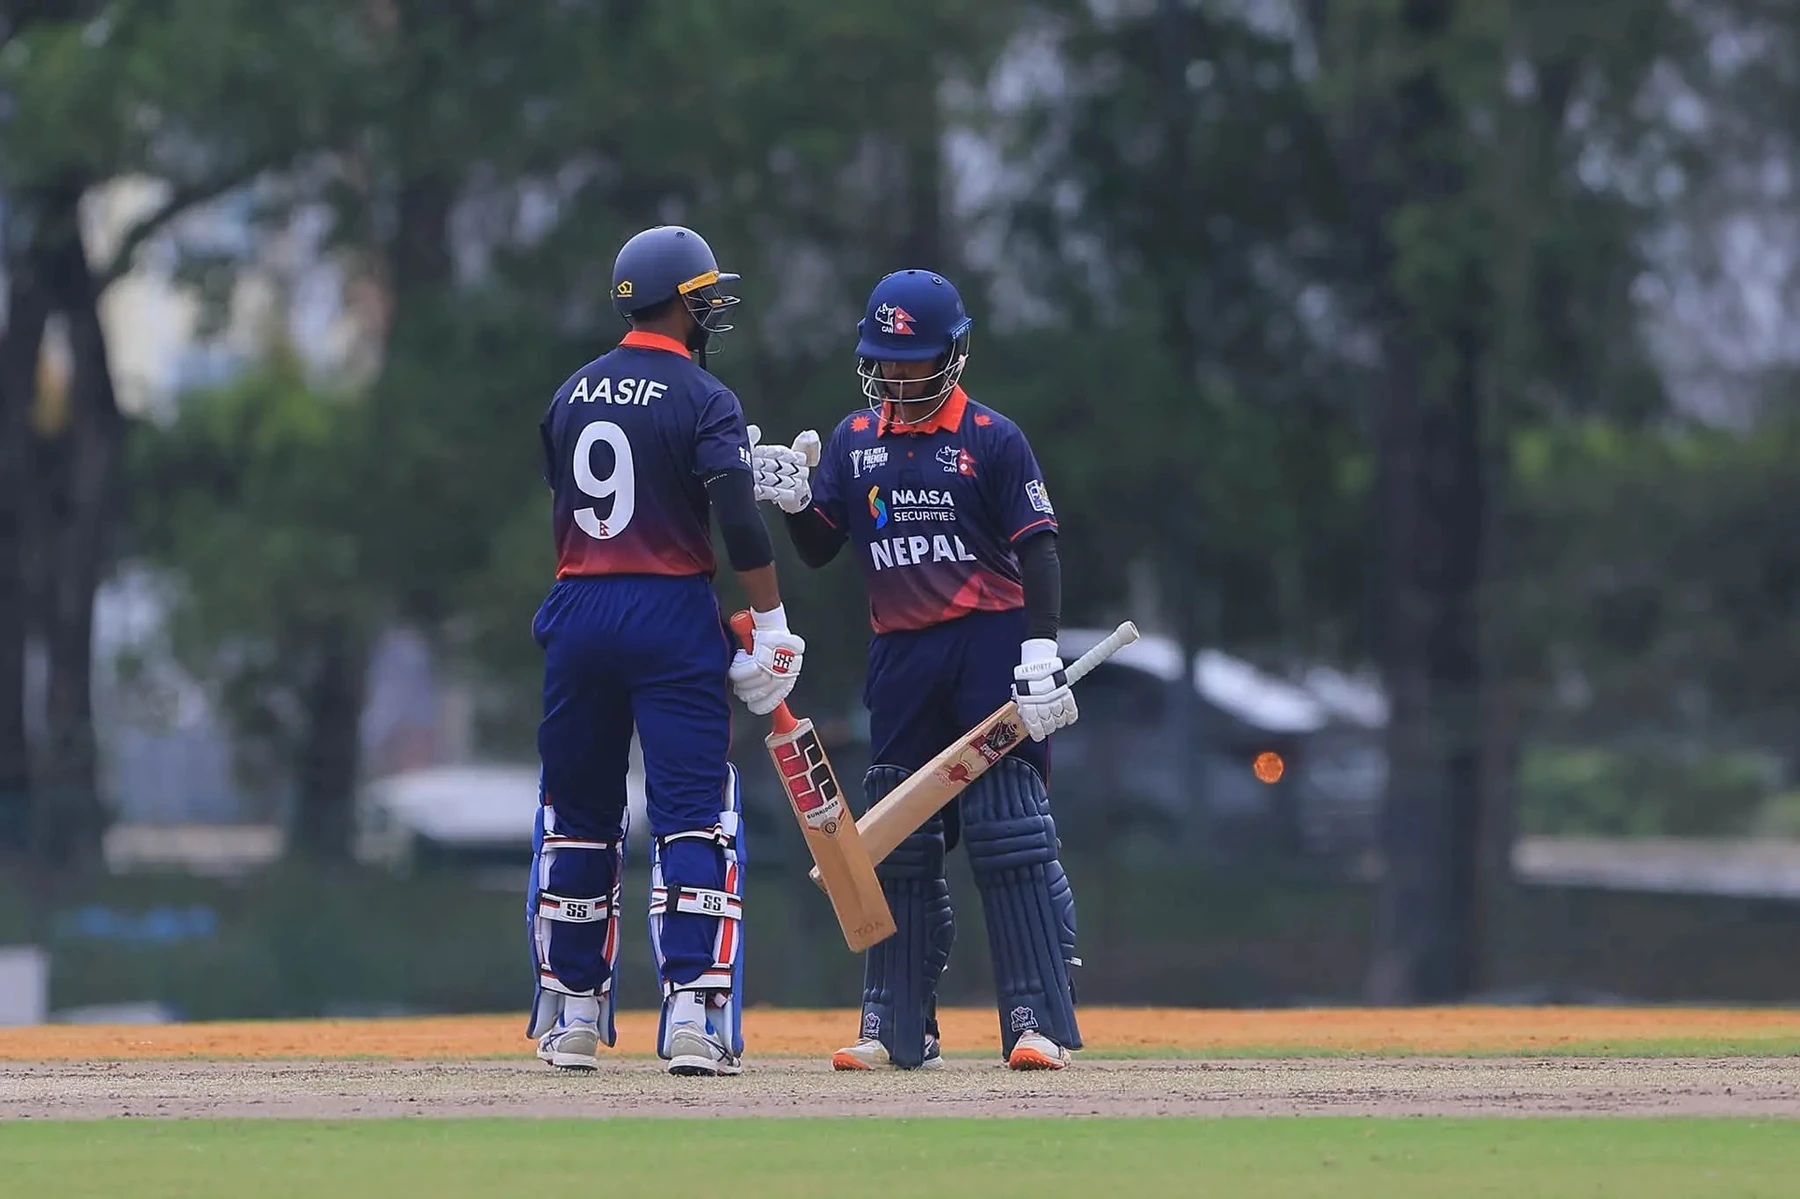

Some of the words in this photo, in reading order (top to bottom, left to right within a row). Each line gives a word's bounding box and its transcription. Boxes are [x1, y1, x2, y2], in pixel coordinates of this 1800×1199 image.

[881, 325, 894, 334] CAN
[568, 377, 668, 406] AASIF
[943, 465, 957, 473] CAN
[573, 420, 635, 540] 9
[891, 489, 955, 507] NAASA
[893, 510, 956, 522] SECURITIES
[870, 535, 977, 570] NEPAL
[566, 903, 588, 918] SS
[703, 894, 722, 912] SS
